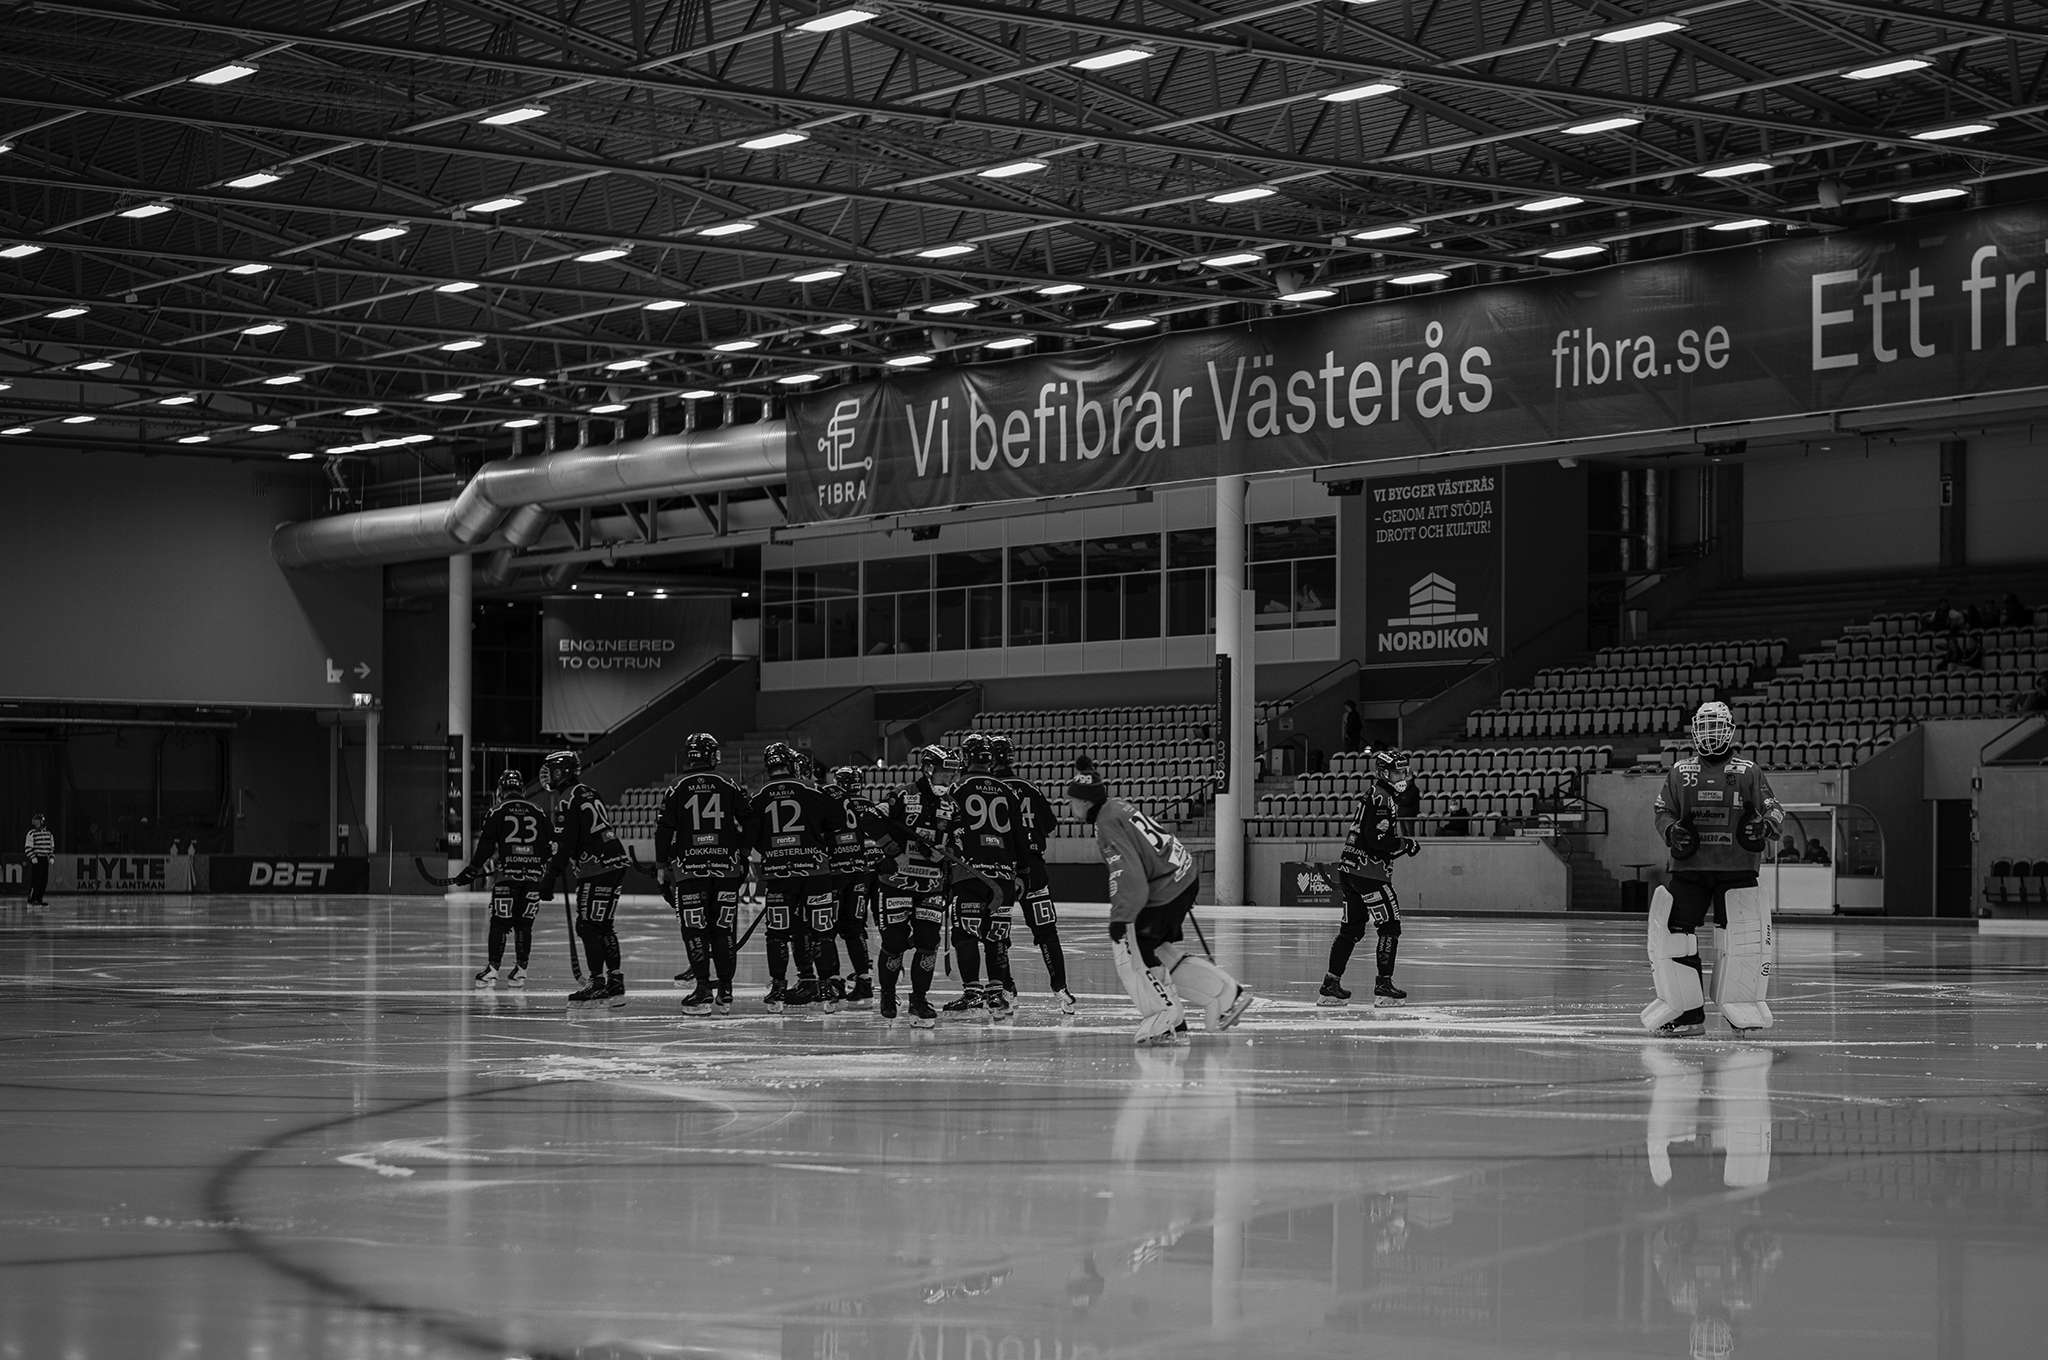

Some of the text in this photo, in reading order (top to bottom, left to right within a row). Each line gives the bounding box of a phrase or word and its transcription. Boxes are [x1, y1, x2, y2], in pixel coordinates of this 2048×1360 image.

[1811, 268, 1935, 371] Ett
[1551, 325, 1730, 389] fibra.se
[906, 320, 1493, 477] Vi befibrar Västerås
[818, 480, 867, 507] FIBRA
[1374, 475, 1495, 502] VI BYGGER VÄSTERÅS
[1383, 507, 1425, 524] GENOM
[1427, 504, 1450, 520] ATT
[1450, 500, 1493, 518] STÖDJA
[1376, 520, 1491, 543] IDROTT OCH KULTUR!
[559, 639, 676, 652] ENGINEERED
[1378, 627, 1489, 652] NORDIKON
[559, 656, 662, 670] TO OUTRUN
[688, 784, 716, 792] MARIA
[1681, 772, 1699, 787] 35
[683, 793, 725, 830] 14
[764, 799, 806, 834] 12
[503, 815, 539, 844] 23
[765, 847, 818, 859] WESTERLING
[77, 858, 165, 880] HYLTE
[249, 862, 335, 886] DBET
[116, 881, 165, 889] LANTMAN
